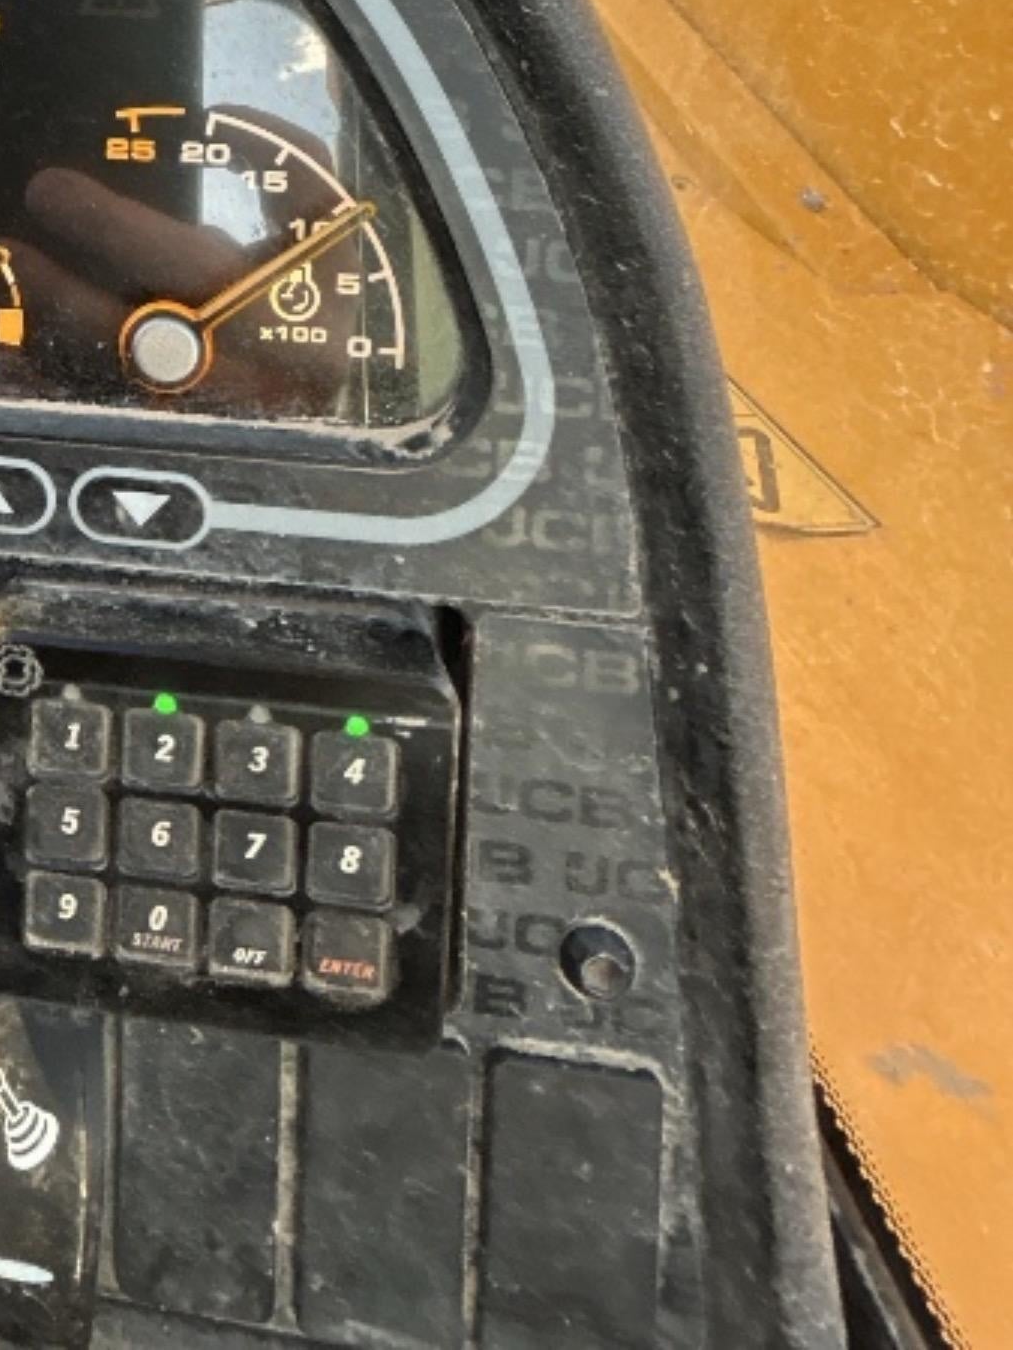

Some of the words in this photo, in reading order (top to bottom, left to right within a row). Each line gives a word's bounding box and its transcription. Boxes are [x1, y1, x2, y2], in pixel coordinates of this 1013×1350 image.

[104, 137, 157, 163] 25
[179, 140, 232, 166] 20
[240, 169, 289, 194] 15
[336, 272, 362, 296] 5
[346, 335, 373, 360] 0
[64, 722, 83, 751] 1
[154, 734, 176, 764] 2
[247, 746, 270, 774] 3
[343, 756, 367, 786] 4
[60, 806, 82, 836] 5
[151, 820, 172, 848] 6
[244, 832, 267, 860] 7
[340, 845, 363, 875] 8
[57, 891, 79, 921] 9
[147, 904, 169, 932] 0
[131, 930, 184, 952] START
[232, 947, 268, 965] OFF
[318, 956, 377, 981] ENTER
